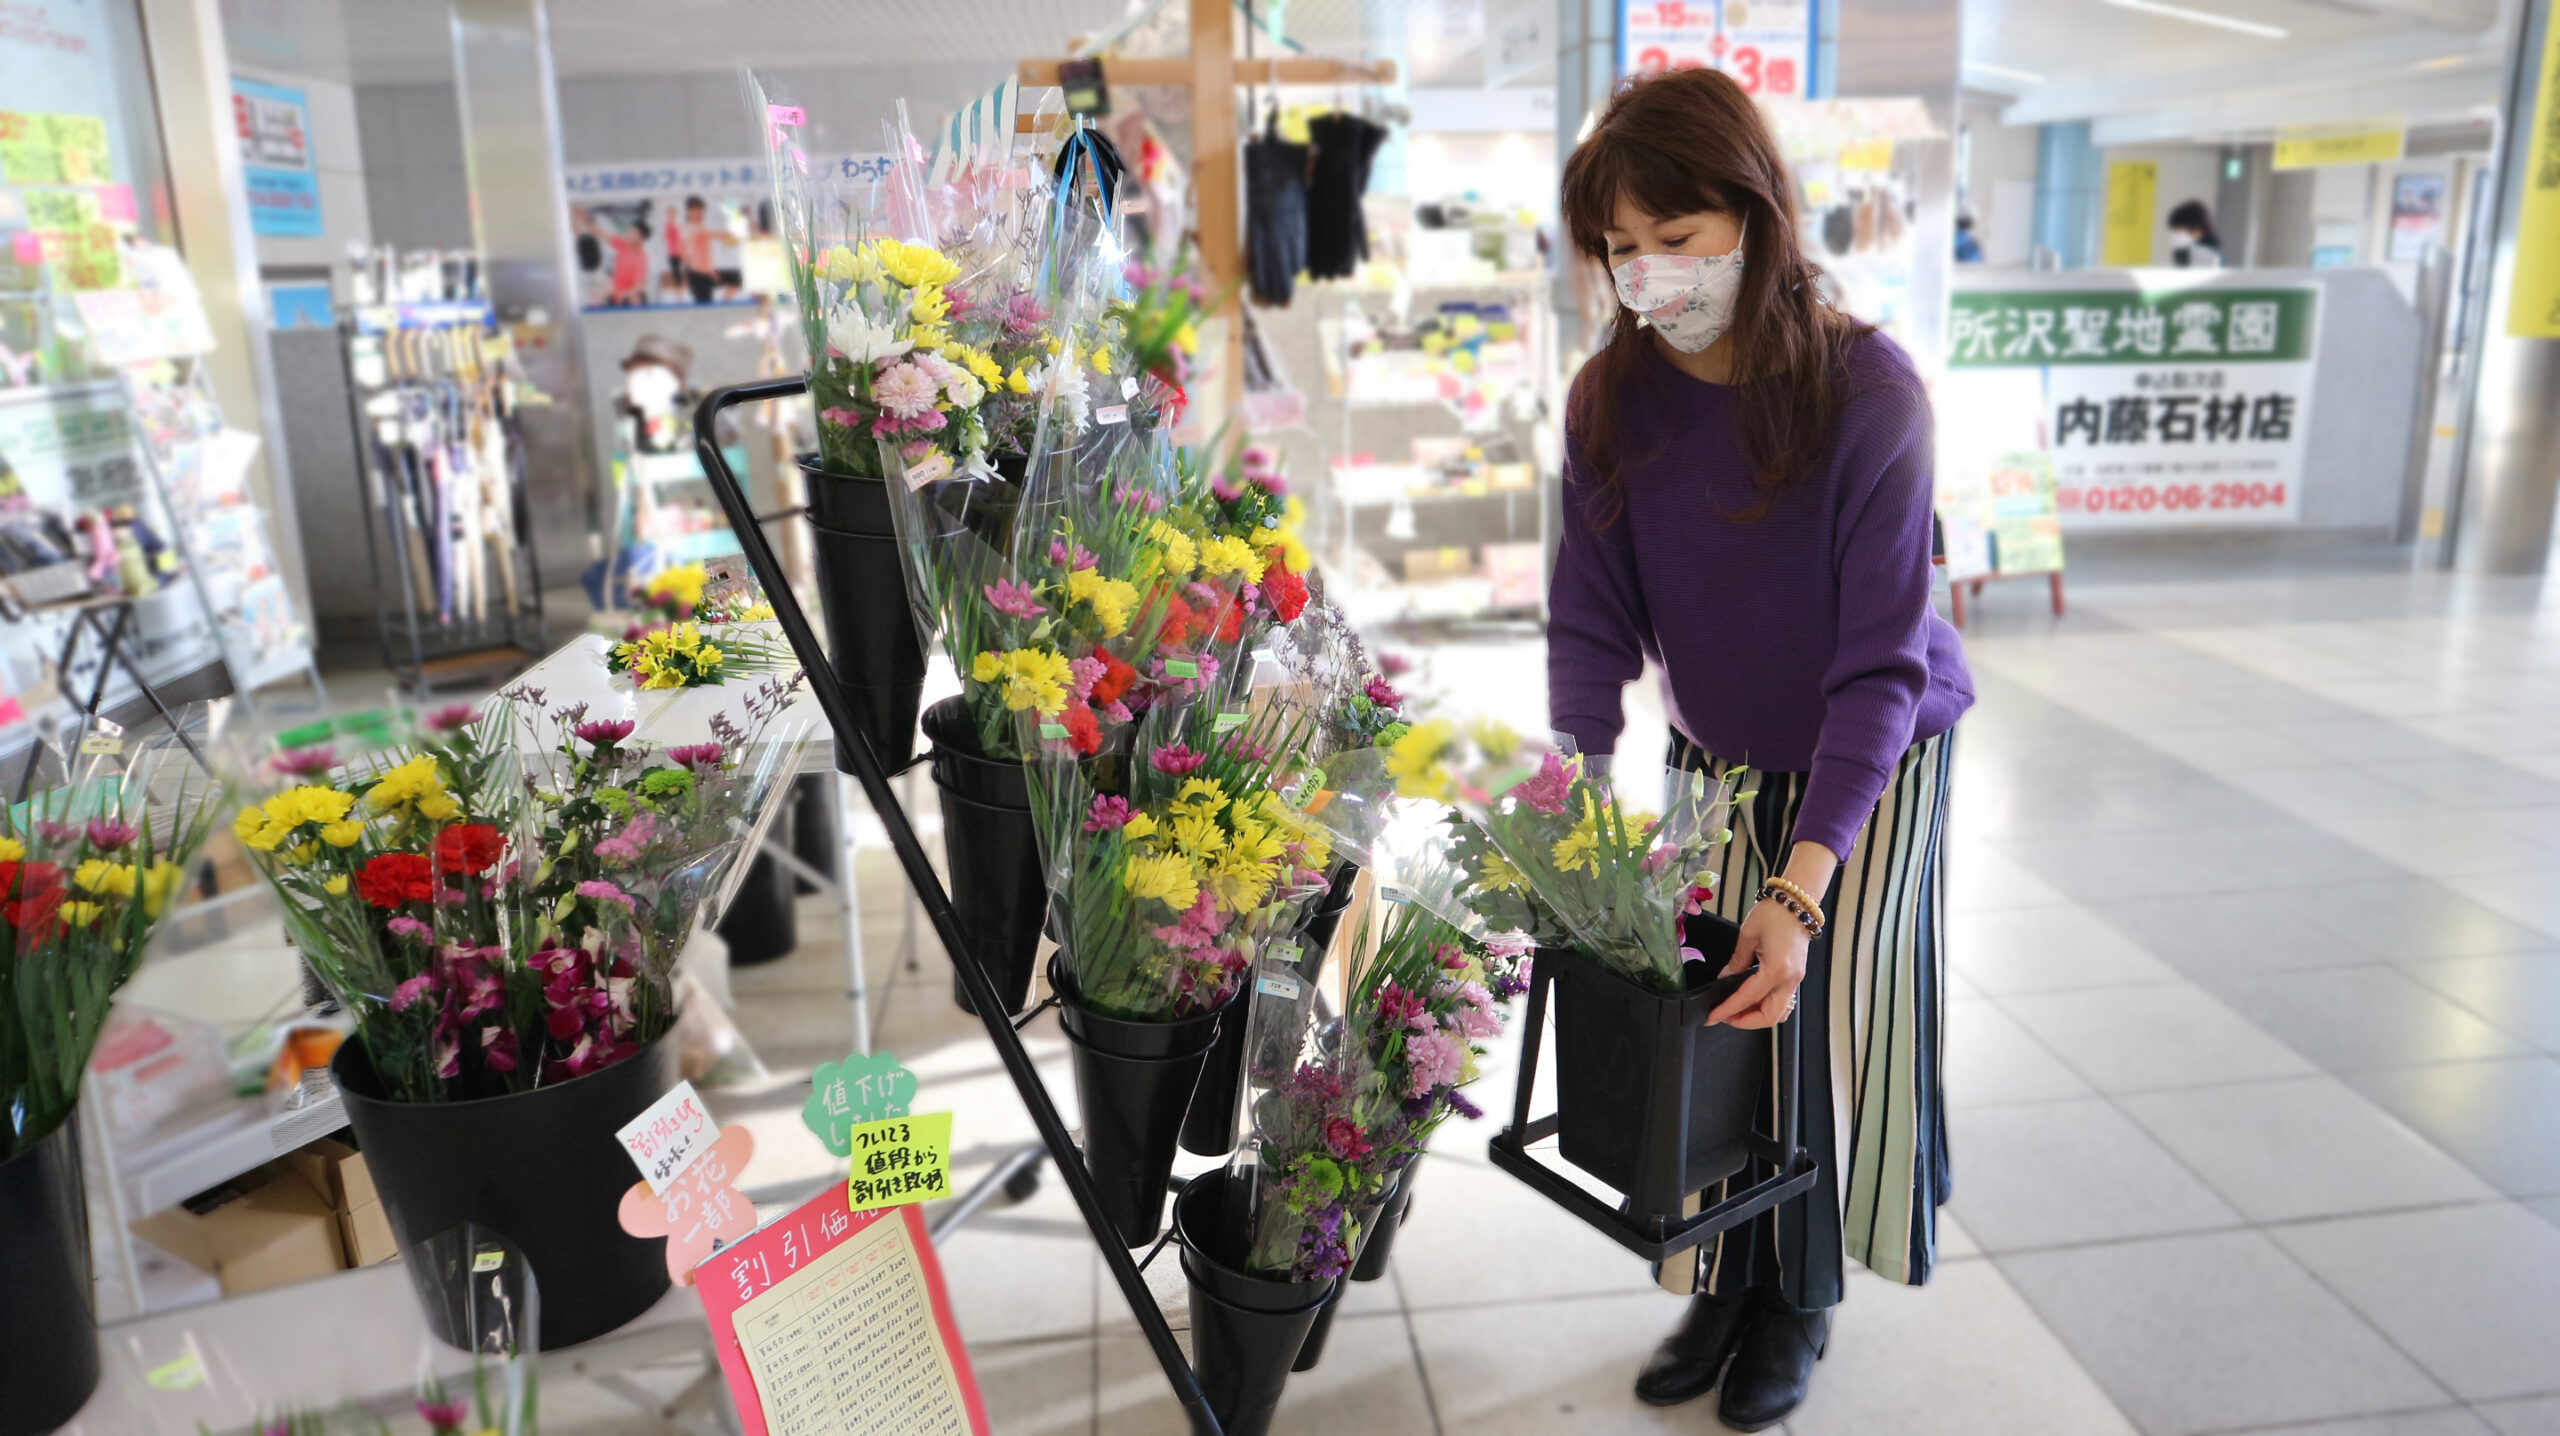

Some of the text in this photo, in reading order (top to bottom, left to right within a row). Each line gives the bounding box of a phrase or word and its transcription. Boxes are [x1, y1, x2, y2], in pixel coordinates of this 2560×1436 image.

[1948, 301, 2280, 360] 所沢聖地霊園
[2056, 390, 2296, 447] 内藤石材店
[822, 1072, 905, 1116] 値下げ
[855, 1123, 911, 1149] ついてる
[864, 1145, 938, 1175] 値段から
[660, 1150, 728, 1222] お花
[682, 1189, 734, 1244] 一部
